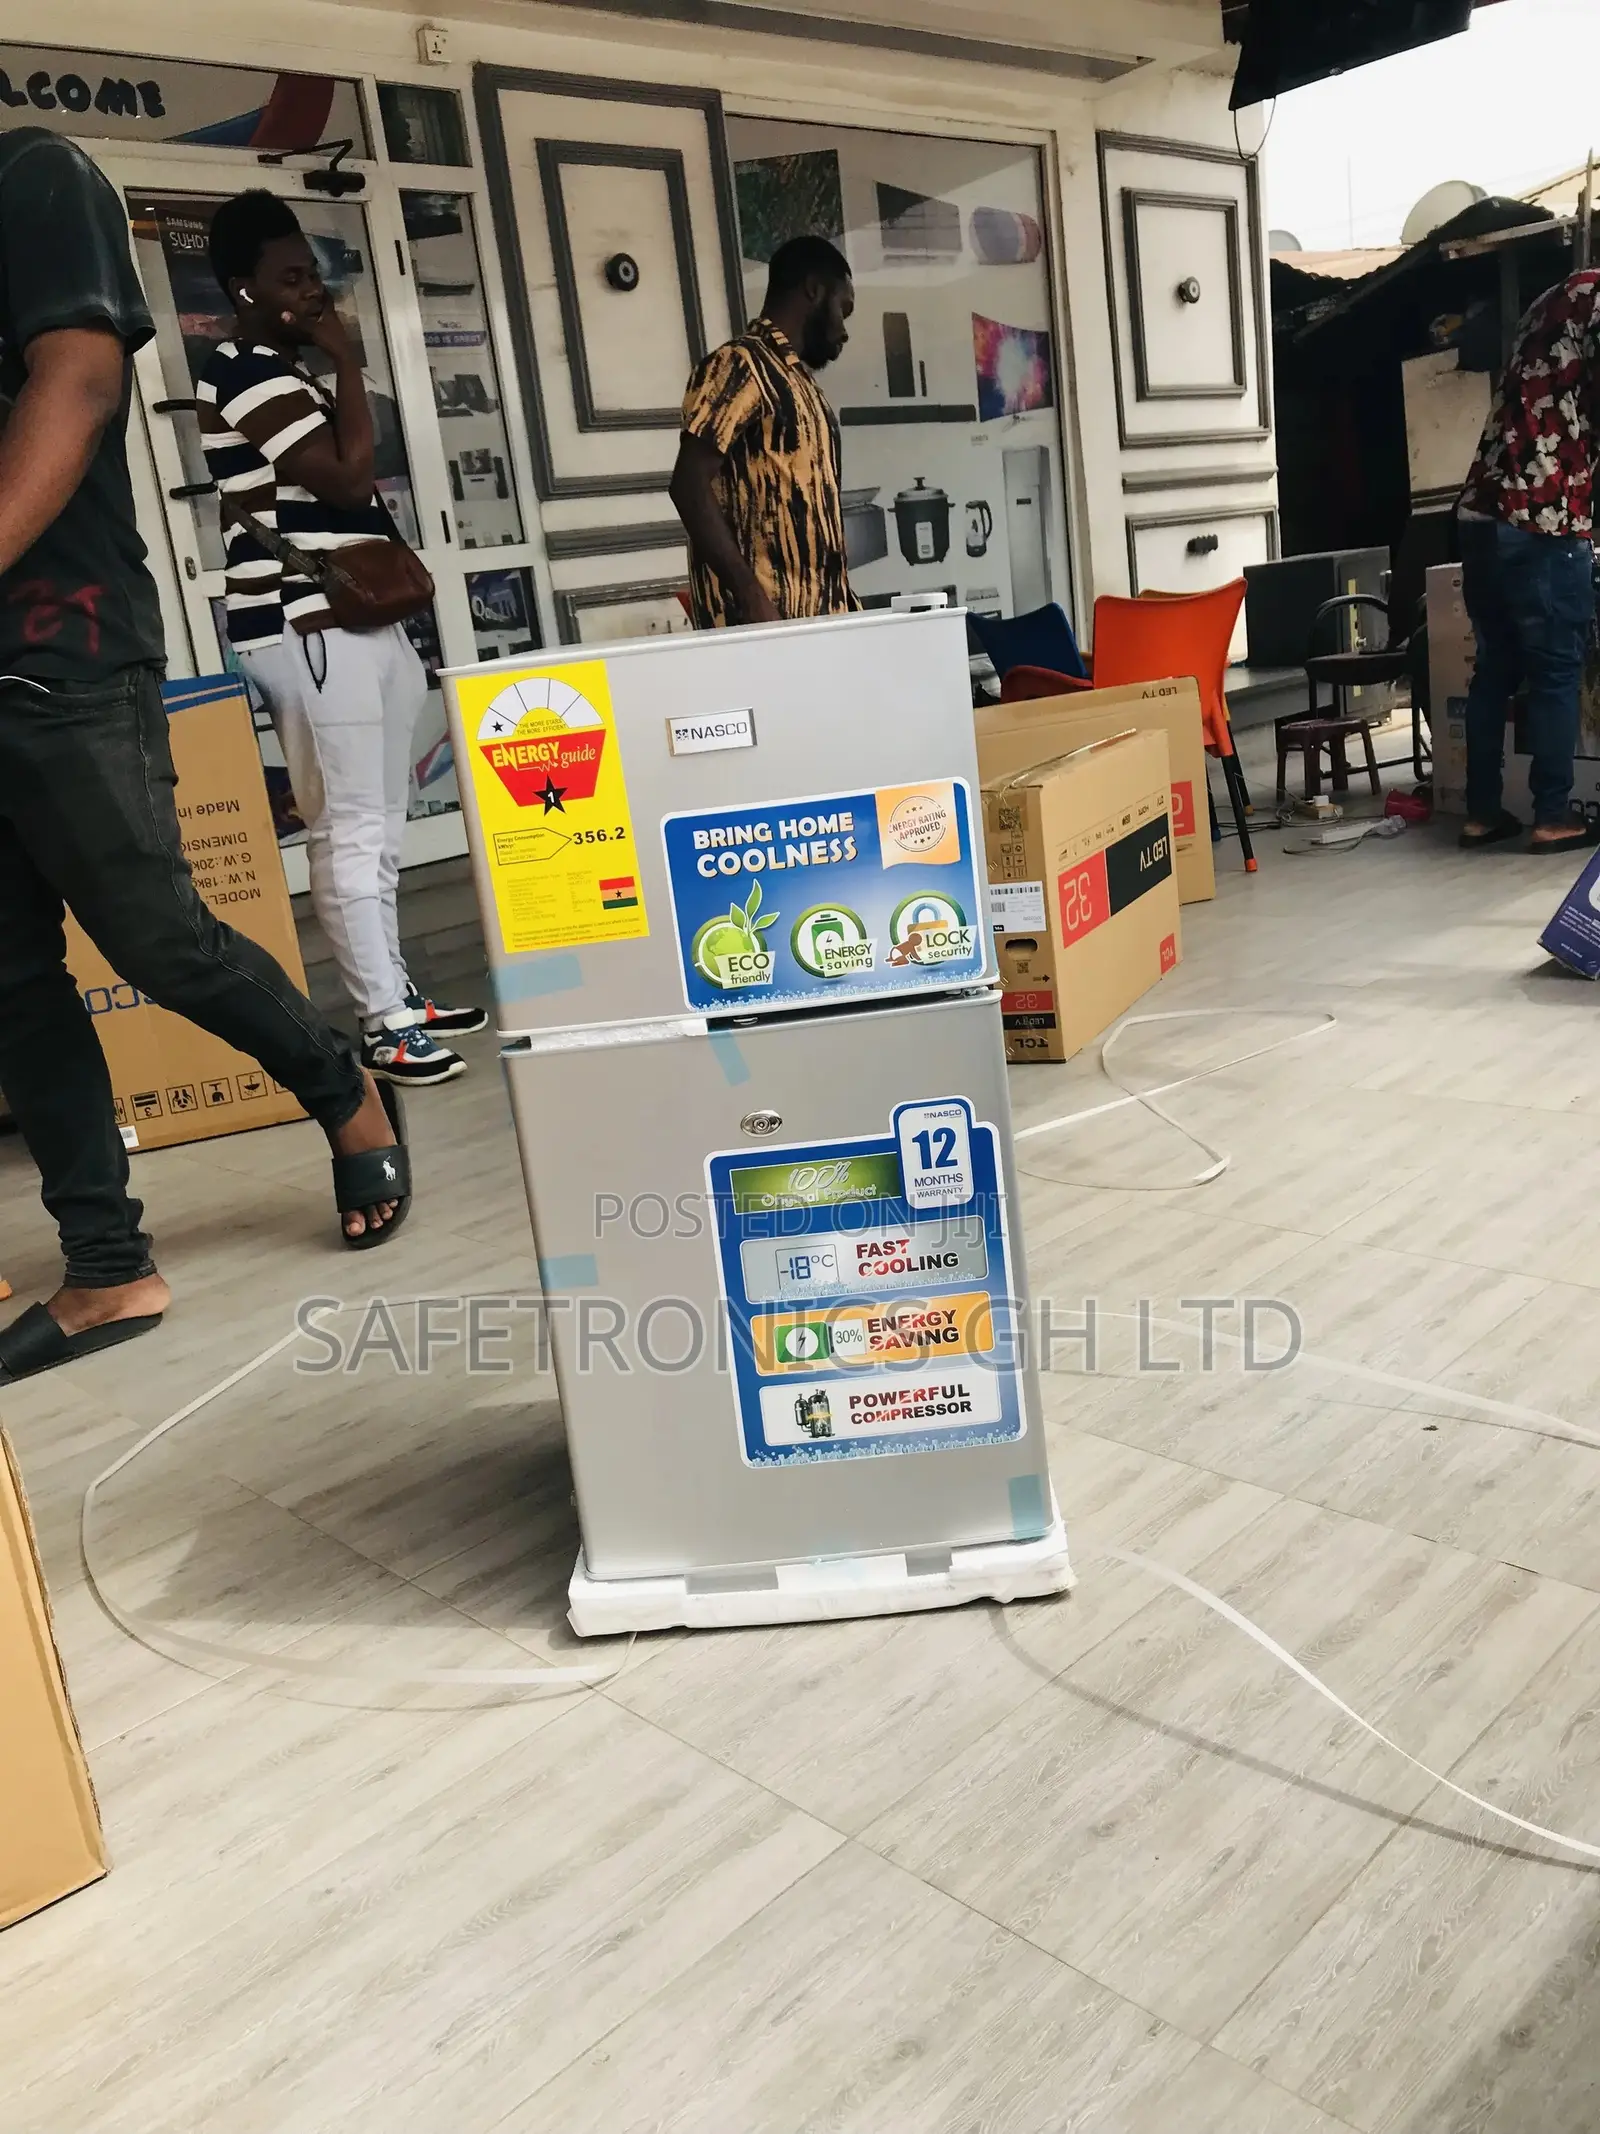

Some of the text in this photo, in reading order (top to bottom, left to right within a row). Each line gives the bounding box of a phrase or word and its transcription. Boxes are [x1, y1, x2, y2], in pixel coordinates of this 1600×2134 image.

[1141, 685, 1178, 699] LED TV
[690, 721, 748, 740] NASCO
[492, 741, 596, 772] ENERGY guide
[547, 791, 555, 803] 1
[178, 799, 240, 818] Made in
[572, 826, 626, 845] 356.2
[692, 812, 855, 850] BRING HOME
[899, 821, 940, 840] APPROVED
[188, 852, 252, 870] G.W.:20k
[697, 836, 858, 878] COOLNESS
[1140, 835, 1168, 872] LED TV
[205, 887, 261, 905] MODEL:
[1063, 871, 1093, 931] 32
[926, 929, 971, 948] LOCK
[824, 943, 873, 960] ENERGY
[928, 945, 972, 960] security
[728, 954, 770, 973] ECO
[827, 957, 873, 971] saving
[731, 971, 771, 985] friendly
[1014, 993, 1038, 1009] 32
[1030, 1017, 1045, 1025] LED
[1014, 1038, 1048, 1048] TCL
[929, 1108, 962, 1119] NASCO
[912, 1127, 958, 1170] 12
[787, 1162, 852, 1192] 100%
[914, 1173, 963, 1188] MONTHS
[761, 1184, 877, 1208] Original Product
[916, 1187, 963, 1198] WARRANTY
[856, 1239, 910, 1259] FAST
[858, 1252, 959, 1278] COOLING
[867, 1309, 957, 1333] ENERGY
[835, 1328, 863, 1345] 30%
[869, 1327, 959, 1351] SAVING
[849, 1384, 970, 1409] POWERFUL
[850, 1401, 972, 1425] COMPRESSOR
